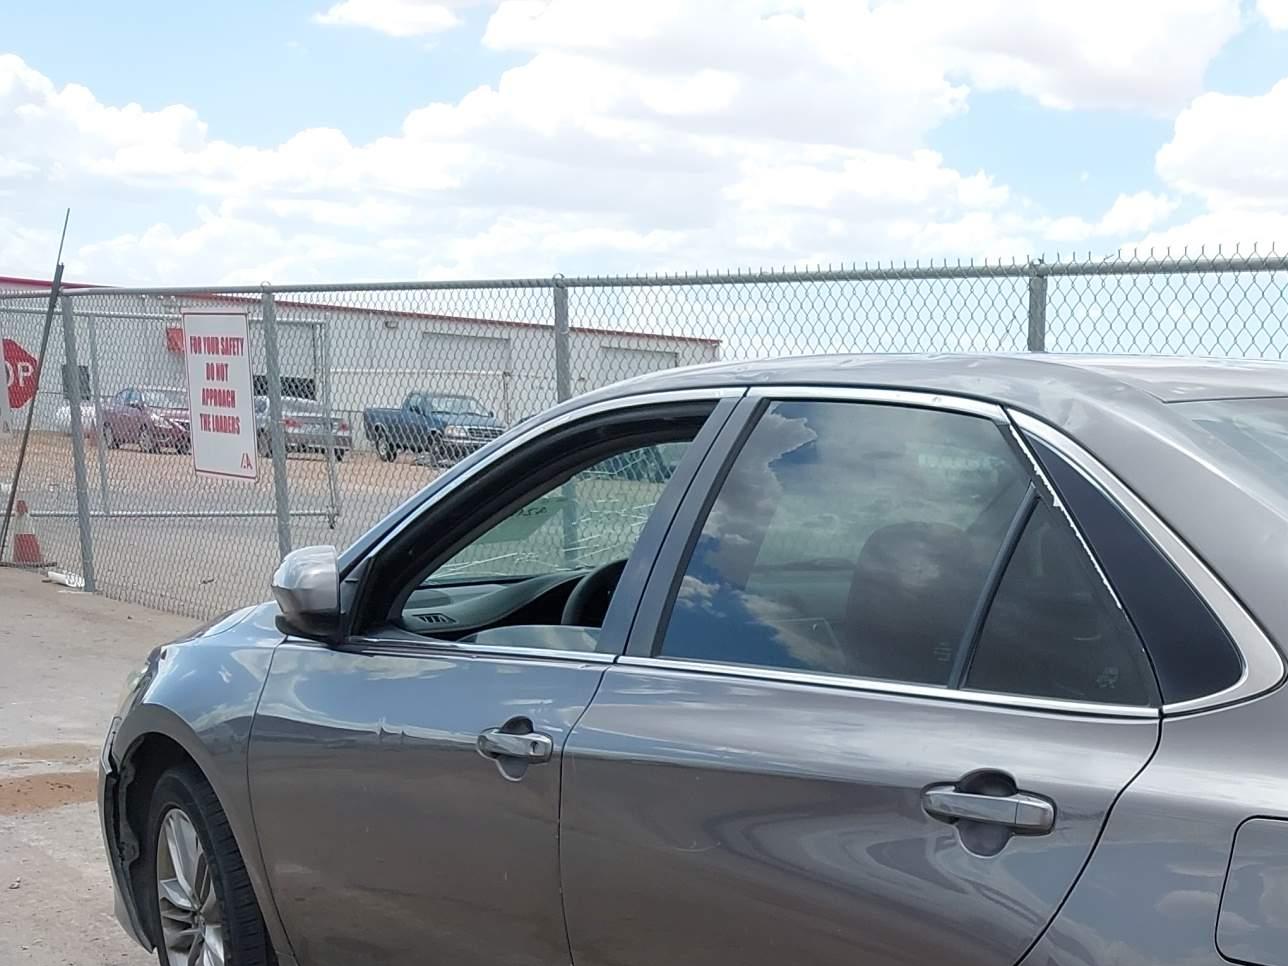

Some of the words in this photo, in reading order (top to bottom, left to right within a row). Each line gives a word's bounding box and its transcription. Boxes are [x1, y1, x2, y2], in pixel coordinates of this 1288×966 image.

[190, 336, 202, 355] FOR
[203, 336, 219, 356] YOUR
[221, 337, 244, 357] SAFETY
[206, 363, 215, 382] DO
[216, 363, 229, 382] NOT
[202, 388, 236, 409] APPROACH
[200, 413, 211, 432] THE
[212, 414, 241, 435] LOADERS
